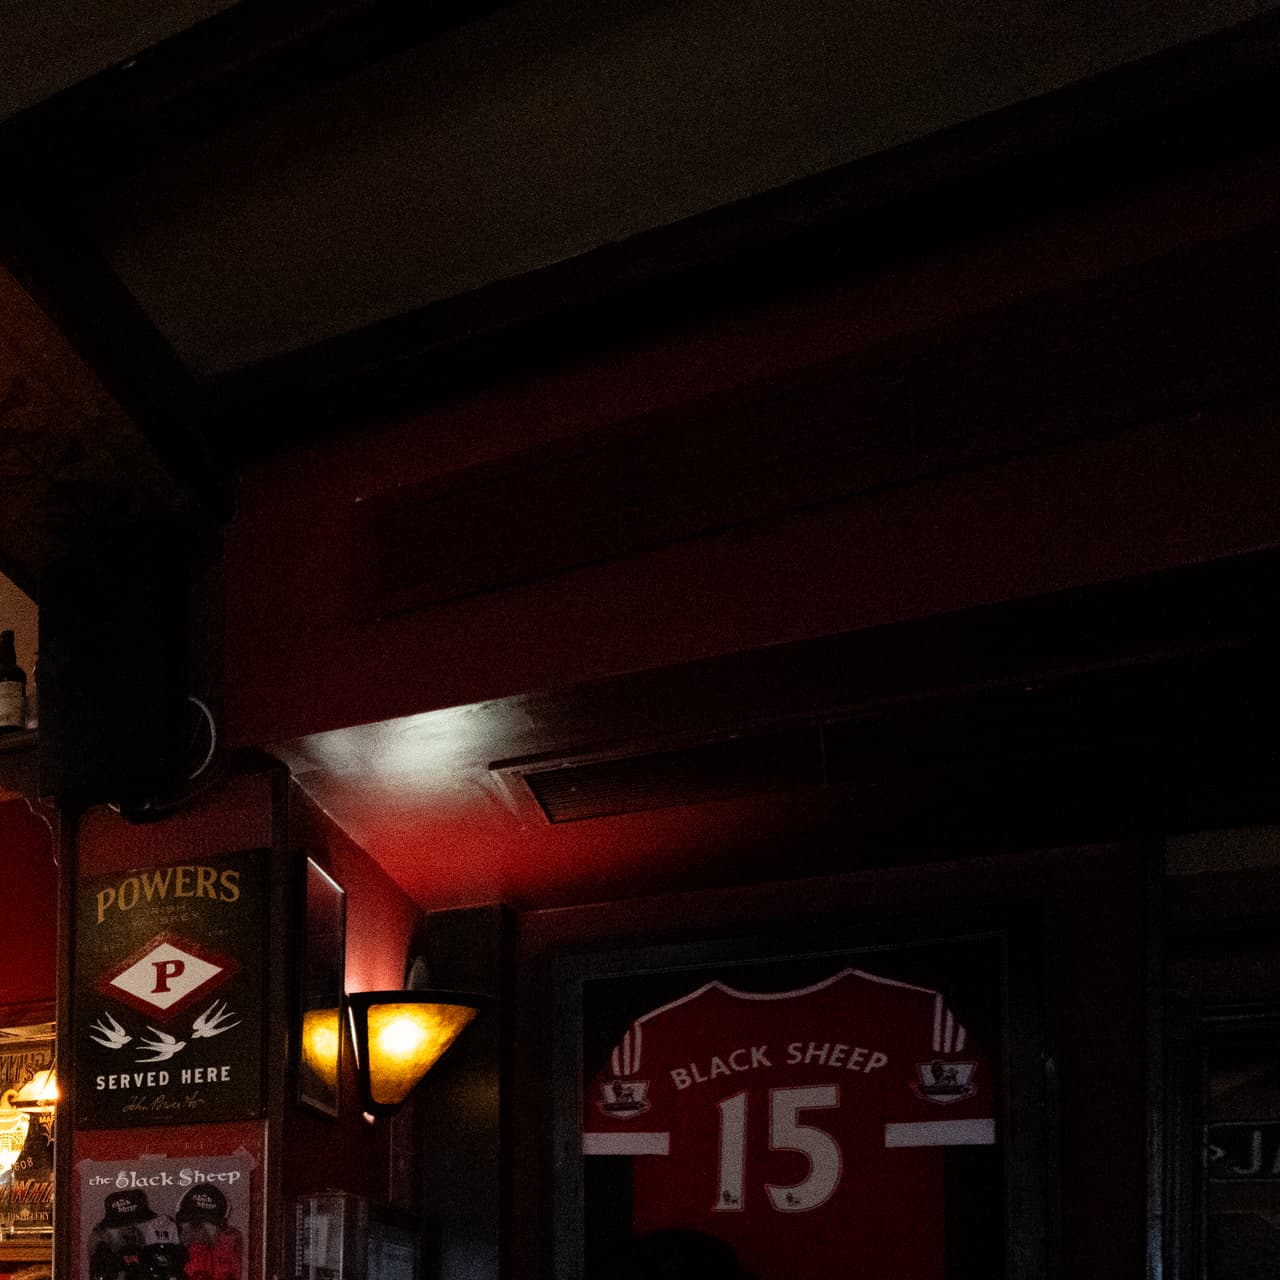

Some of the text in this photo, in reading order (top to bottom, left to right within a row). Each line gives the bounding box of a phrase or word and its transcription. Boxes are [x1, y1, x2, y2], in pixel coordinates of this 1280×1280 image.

[96, 866, 240, 924] POWERS
[150, 959, 185, 994] P
[96, 1066, 231, 1090] SERVED HERE
[670, 1041, 889, 1091] BLACK SHEEP
[711, 1085, 842, 1213] 15
[89, 1168, 240, 1189] the Black Sheep
